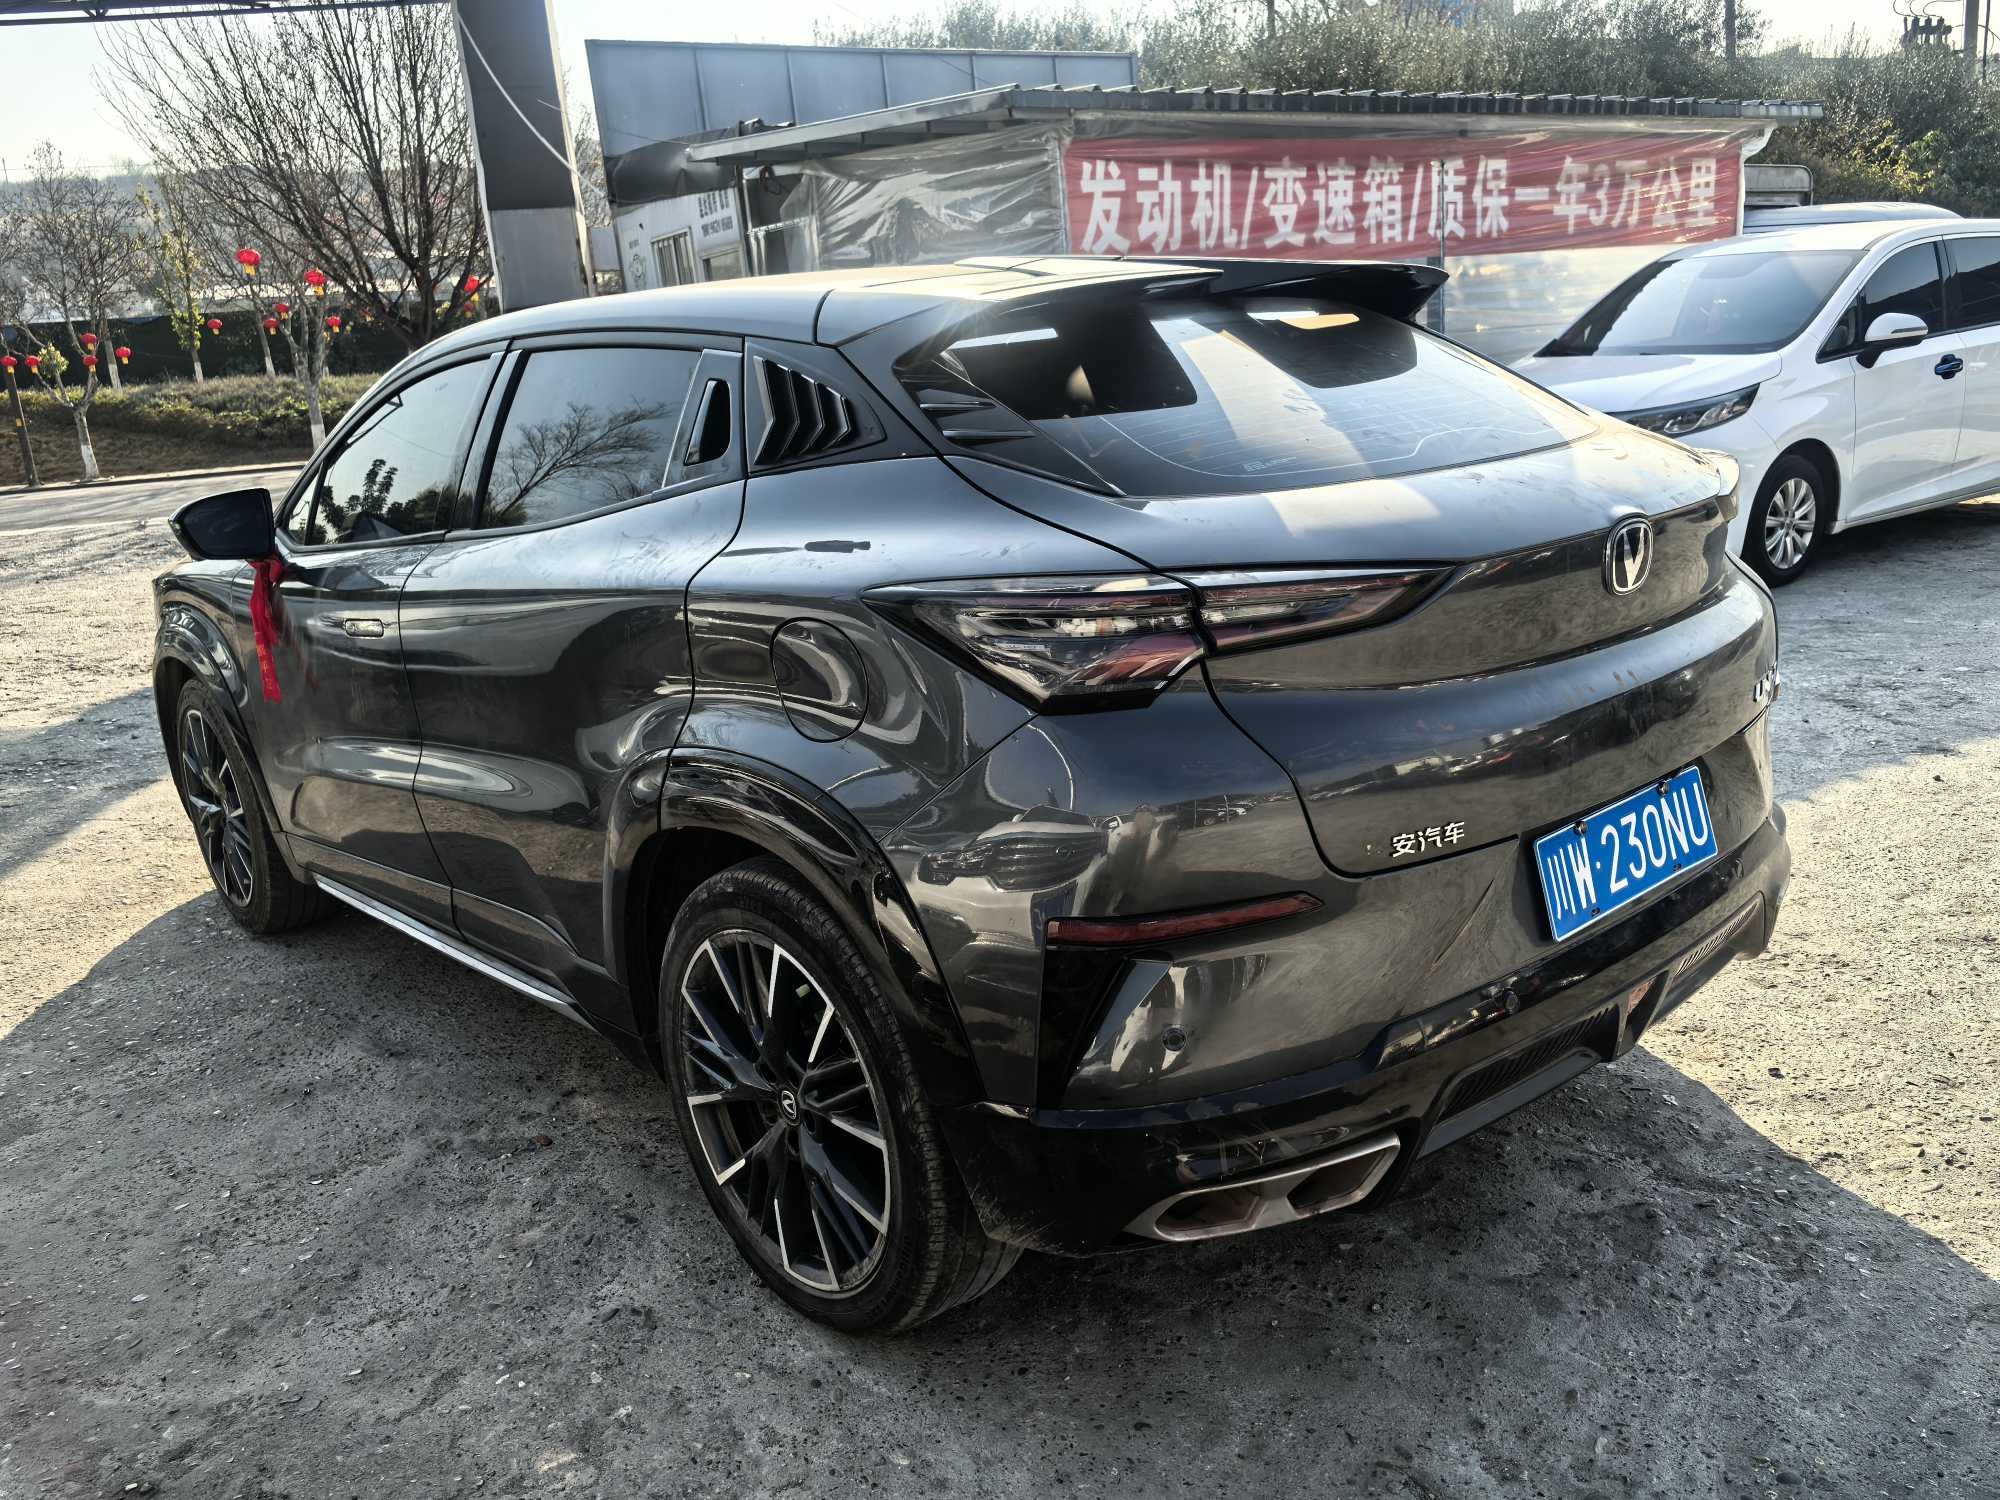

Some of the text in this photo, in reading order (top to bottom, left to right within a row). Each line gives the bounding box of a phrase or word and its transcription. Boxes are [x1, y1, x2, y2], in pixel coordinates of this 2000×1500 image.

[1080, 155, 1716, 254] 发动机/变速箱/质保一年3万公里
[1391, 821, 1465, 858] 安汽车
[1547, 782, 1708, 920] 川W·230NU
